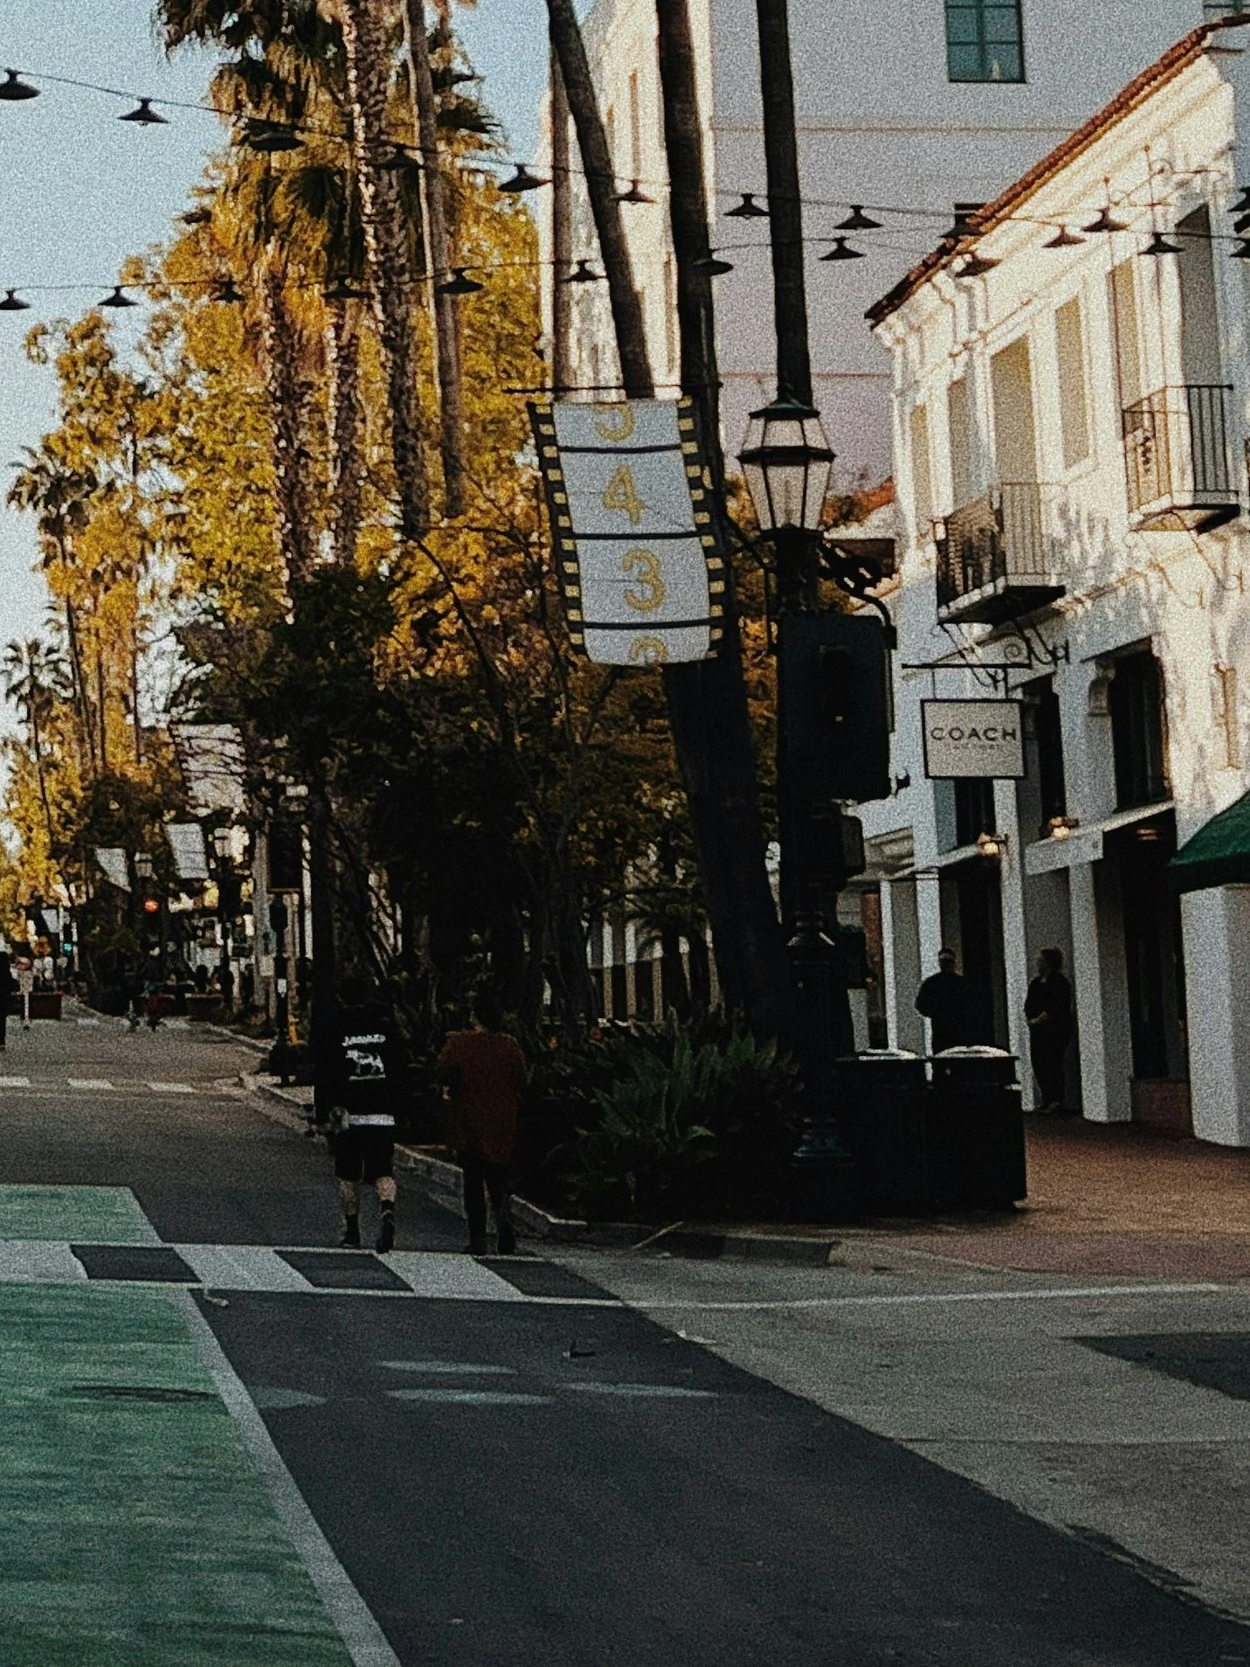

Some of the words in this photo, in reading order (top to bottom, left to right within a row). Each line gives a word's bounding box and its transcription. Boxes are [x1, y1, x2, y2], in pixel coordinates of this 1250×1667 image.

[603, 464, 646, 524] 4
[622, 548, 666, 613] 3
[931, 726, 1017, 741] COACH
